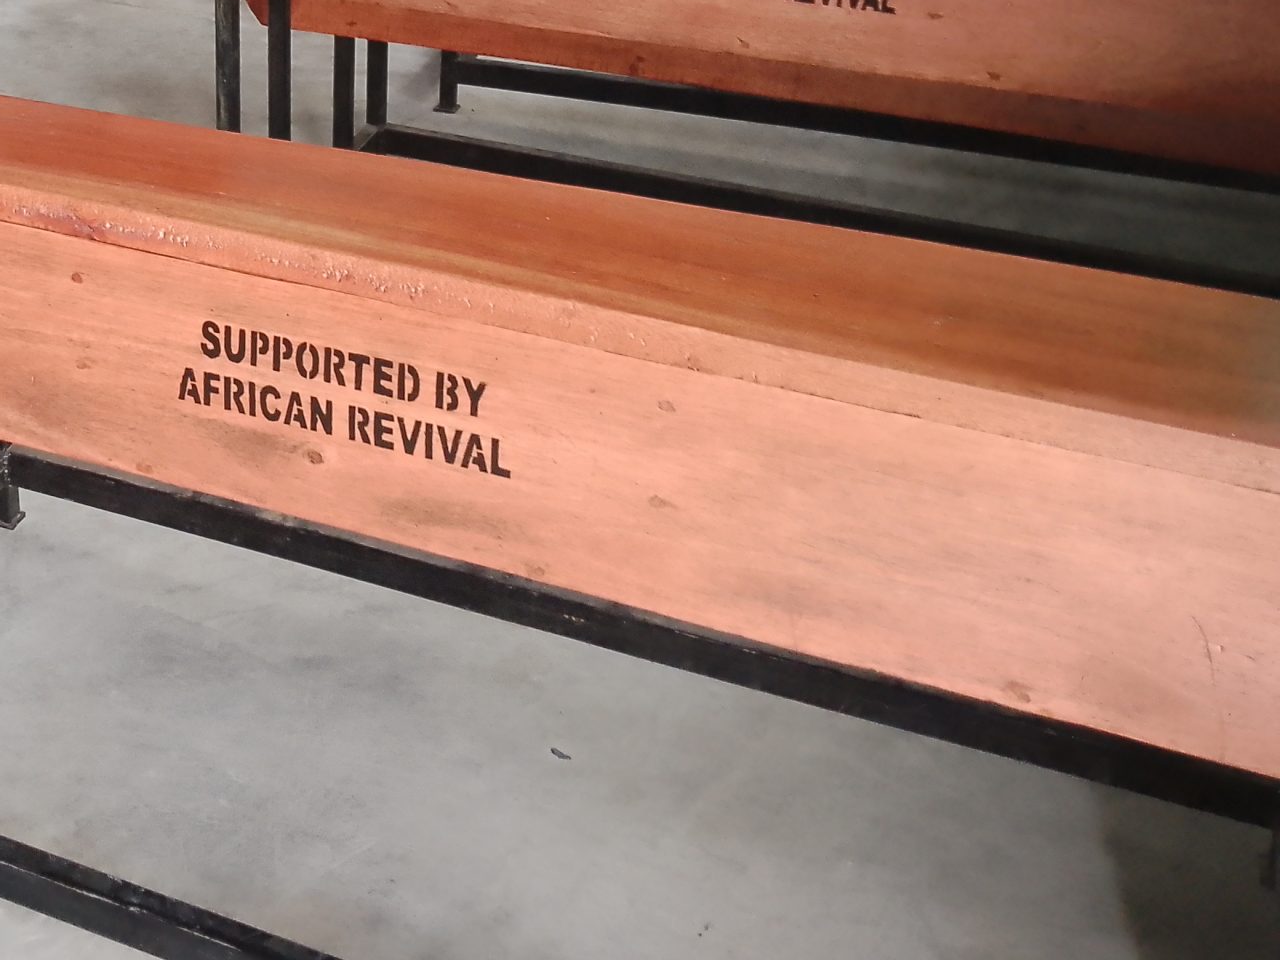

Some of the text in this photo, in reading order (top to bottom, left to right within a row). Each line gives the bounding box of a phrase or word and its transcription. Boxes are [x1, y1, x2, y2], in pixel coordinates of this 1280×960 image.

[199, 320, 488, 417] SUPPORTED BY
[177, 367, 512, 479] AFRICAN REVIVAL
